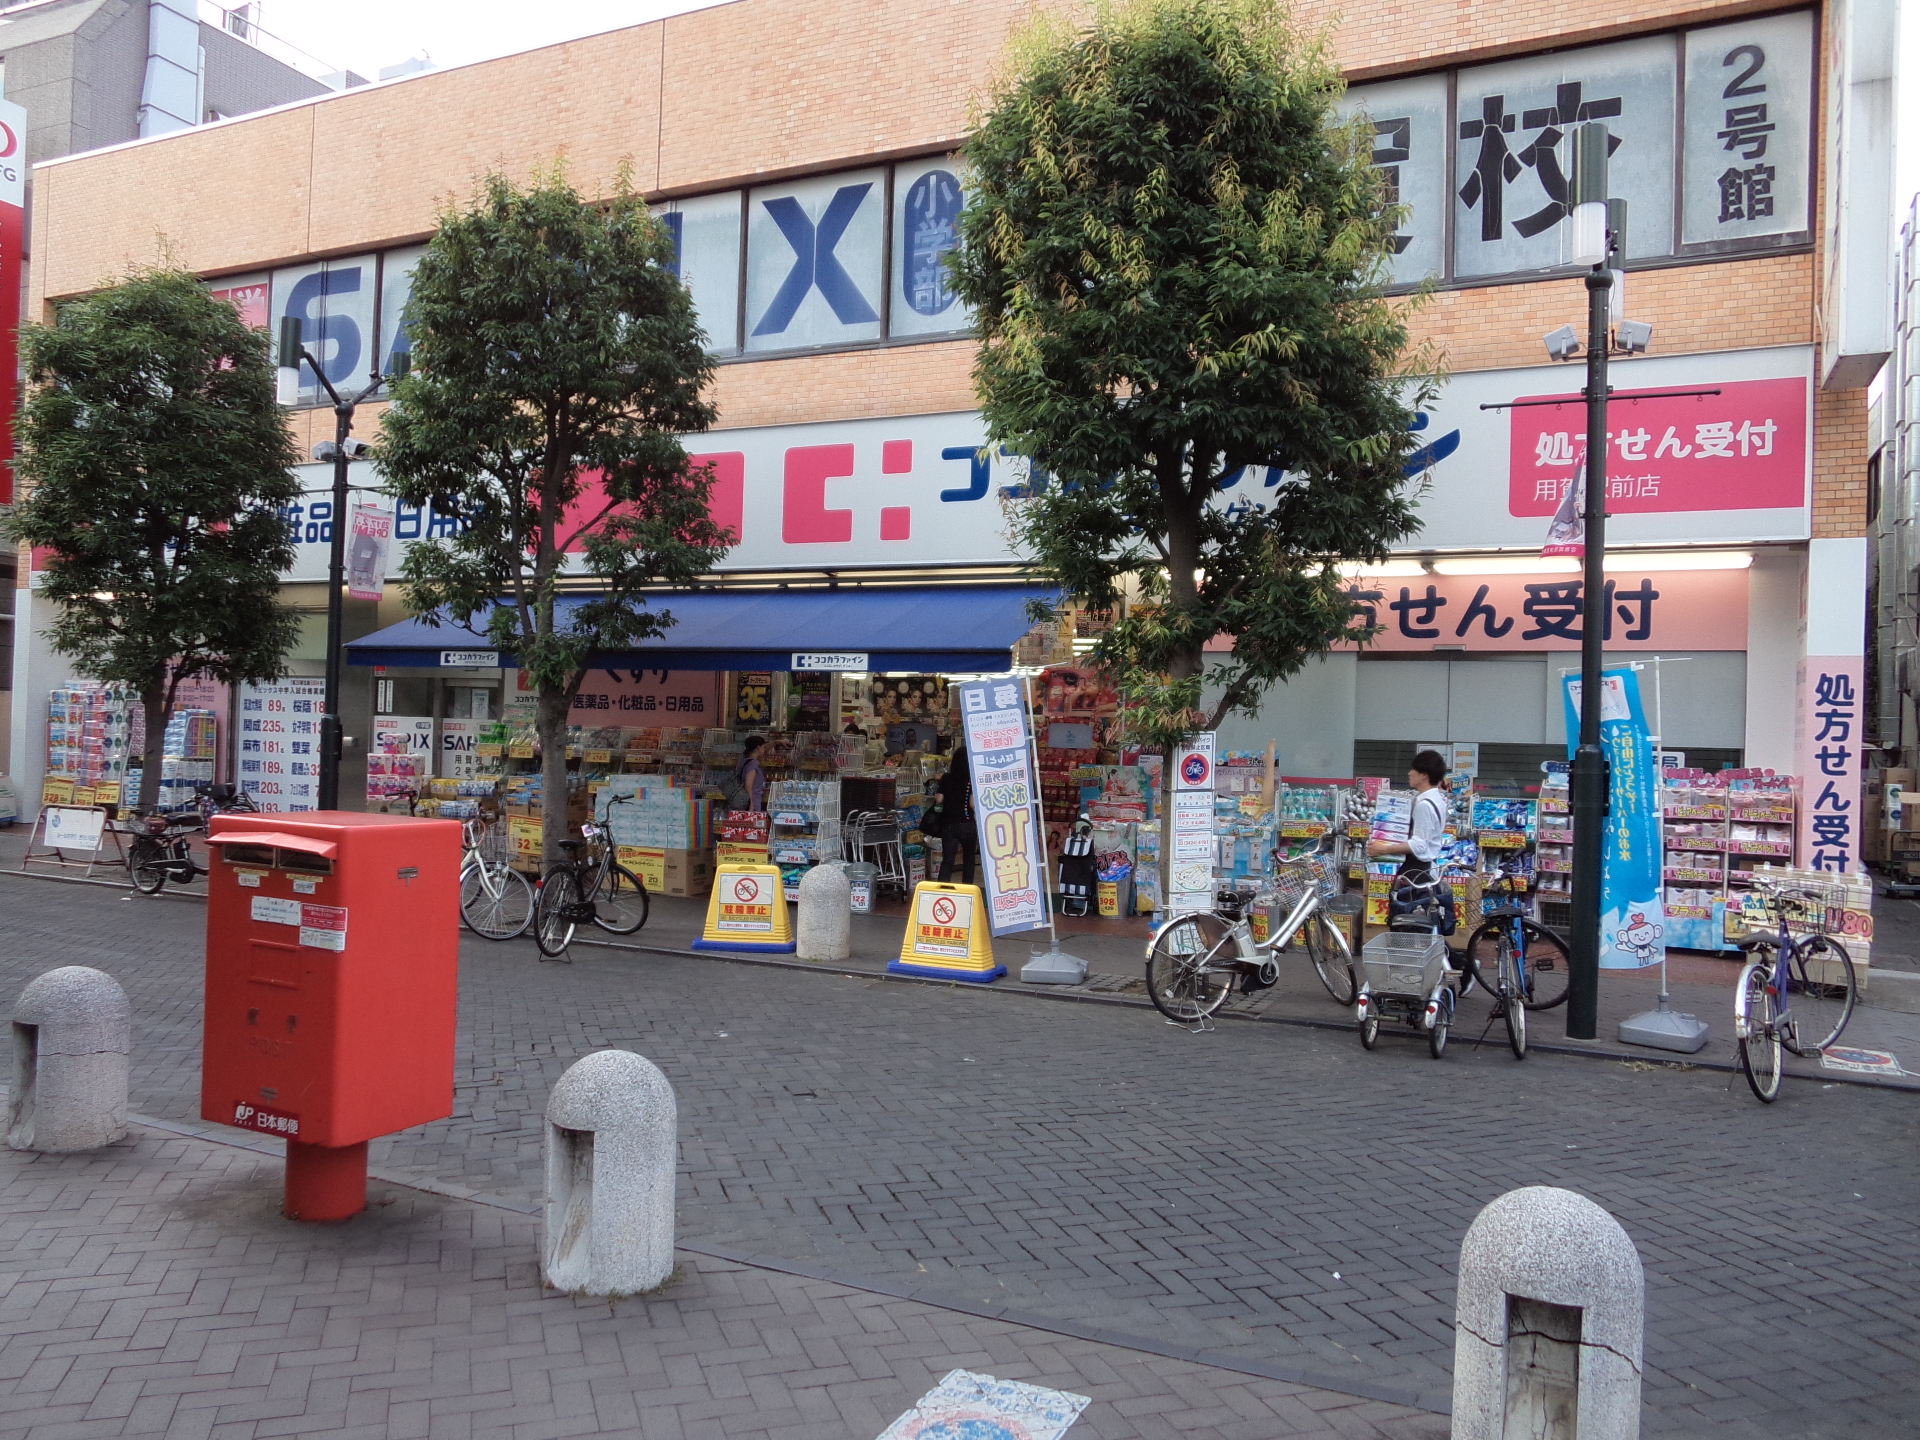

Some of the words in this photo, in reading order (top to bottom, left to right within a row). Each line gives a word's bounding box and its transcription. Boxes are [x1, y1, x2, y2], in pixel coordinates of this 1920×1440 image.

[1716, 45, 1775, 225] 2号館
[814, 655, 864, 664] ココカラファイン
[573, 694, 705, 712] 医薬品・化粧品・日用品
[1812, 673, 1855, 872] 処方せん受付
[257, 1112, 299, 1134] 日本郵便
